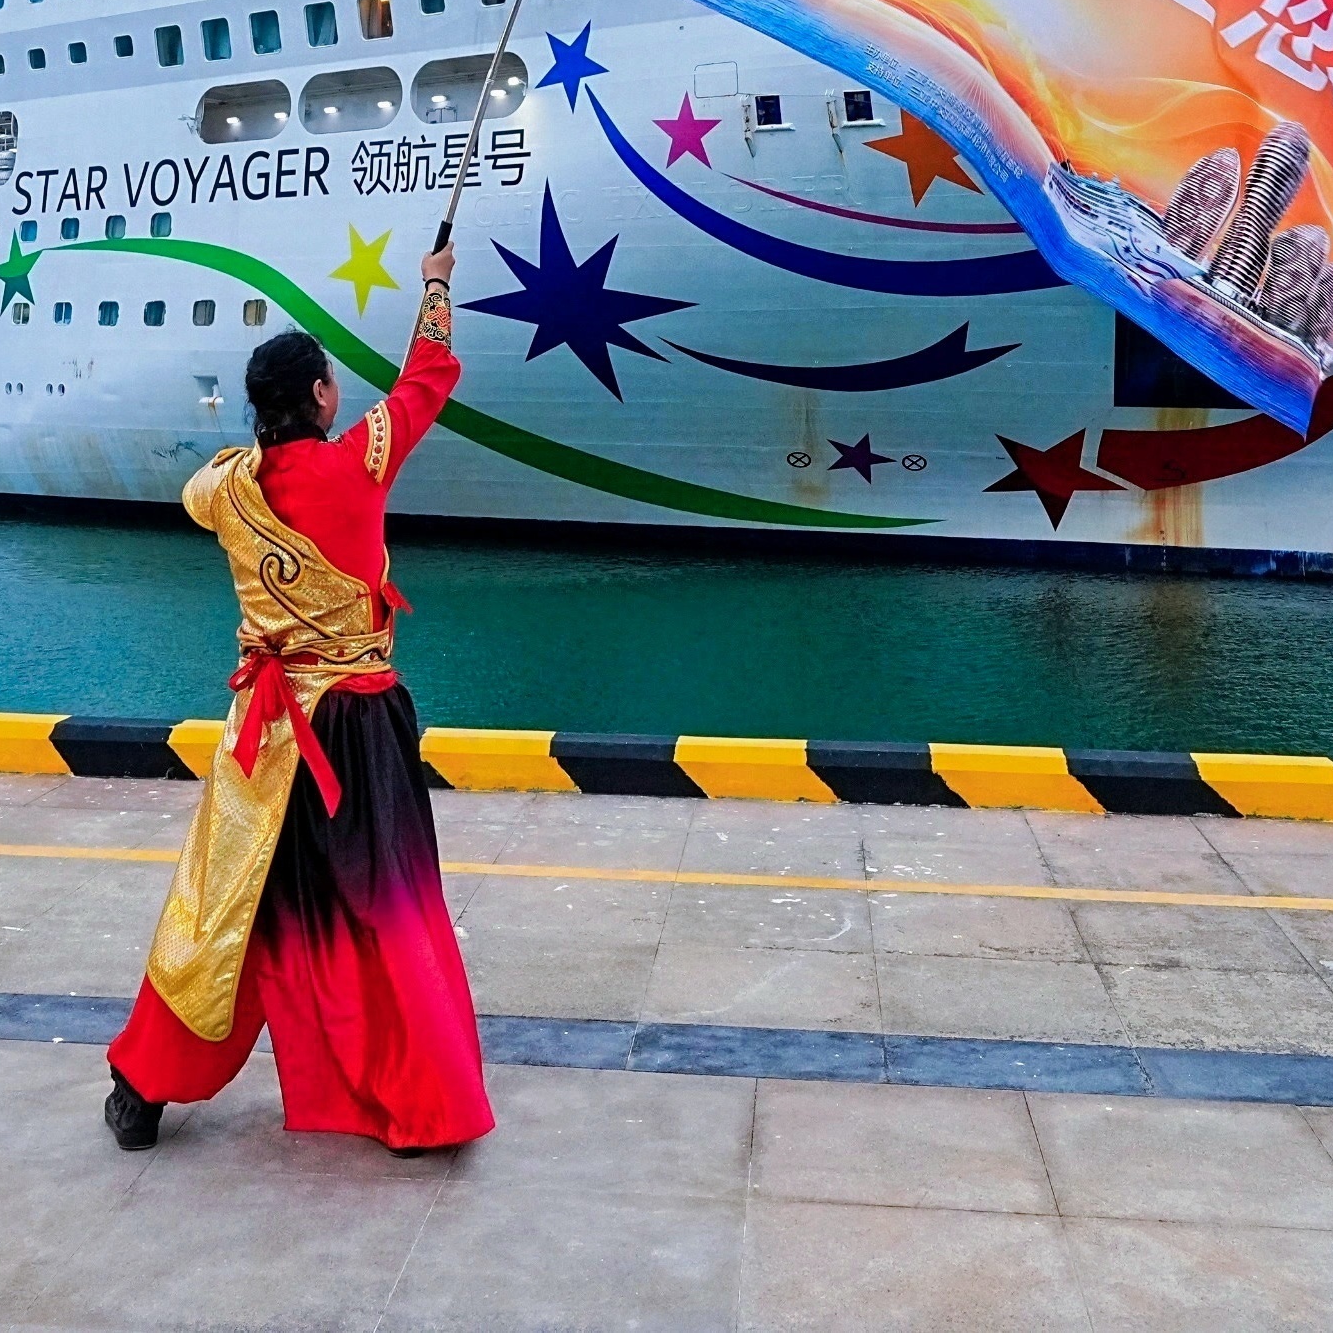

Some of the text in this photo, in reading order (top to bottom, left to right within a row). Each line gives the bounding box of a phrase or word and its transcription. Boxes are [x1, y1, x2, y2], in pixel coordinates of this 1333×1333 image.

[11, 127, 532, 215] STAR VOYAGER 领航星号
